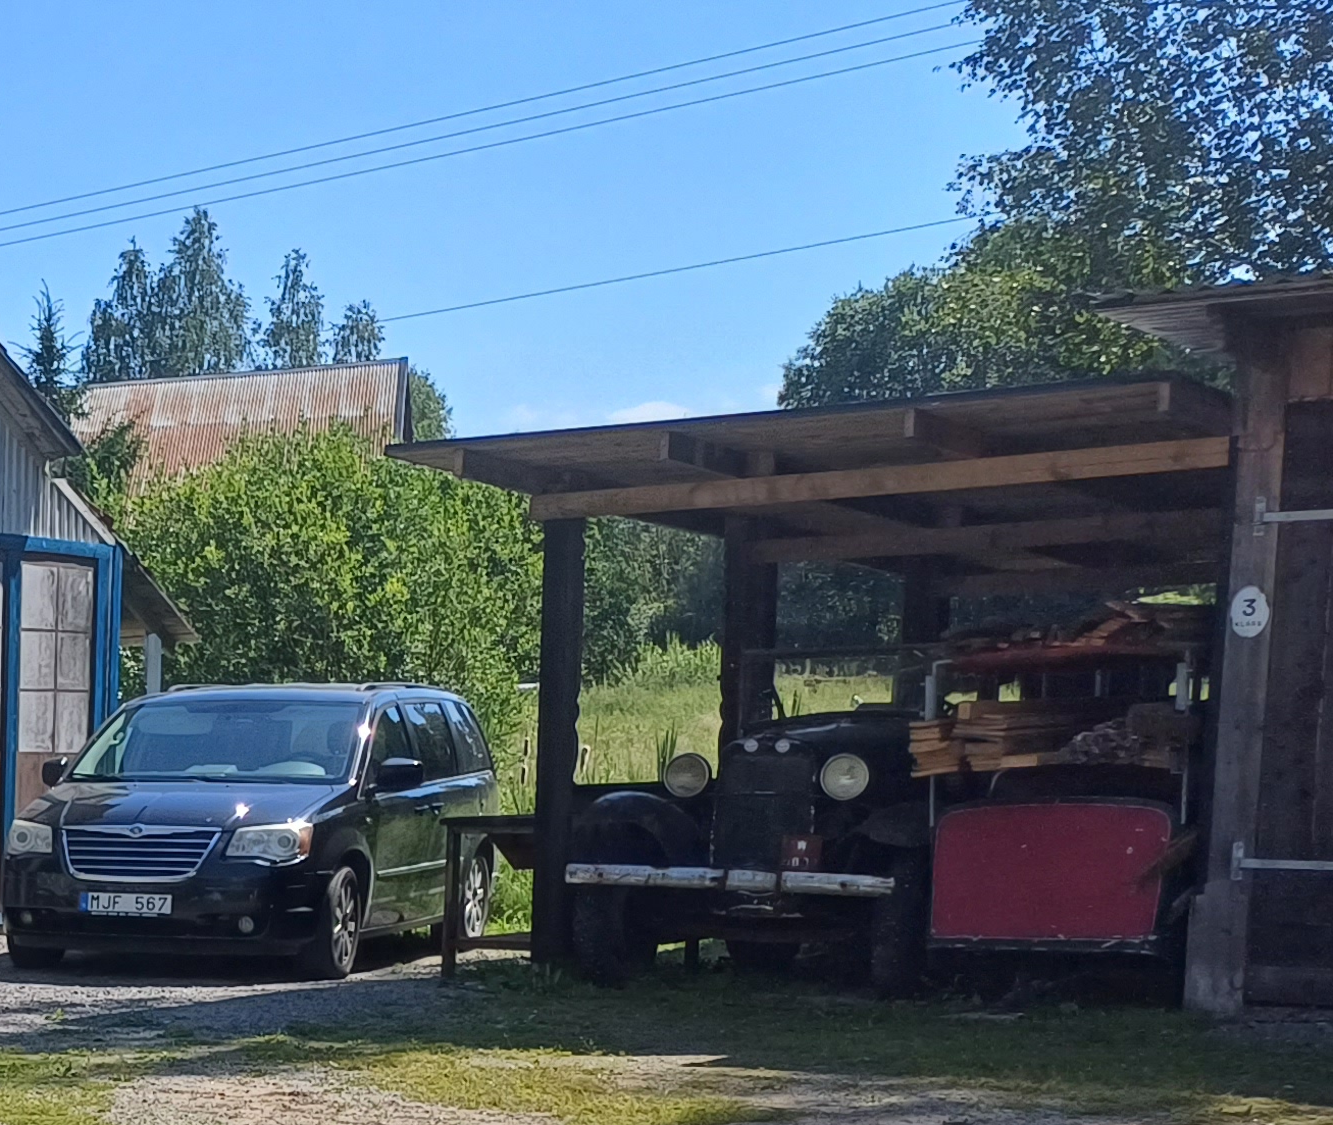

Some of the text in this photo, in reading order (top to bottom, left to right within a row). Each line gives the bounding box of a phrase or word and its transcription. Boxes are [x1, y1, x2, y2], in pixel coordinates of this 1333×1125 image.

[1242, 598, 1256, 617] 3
[90, 894, 168, 911] MJF 567
